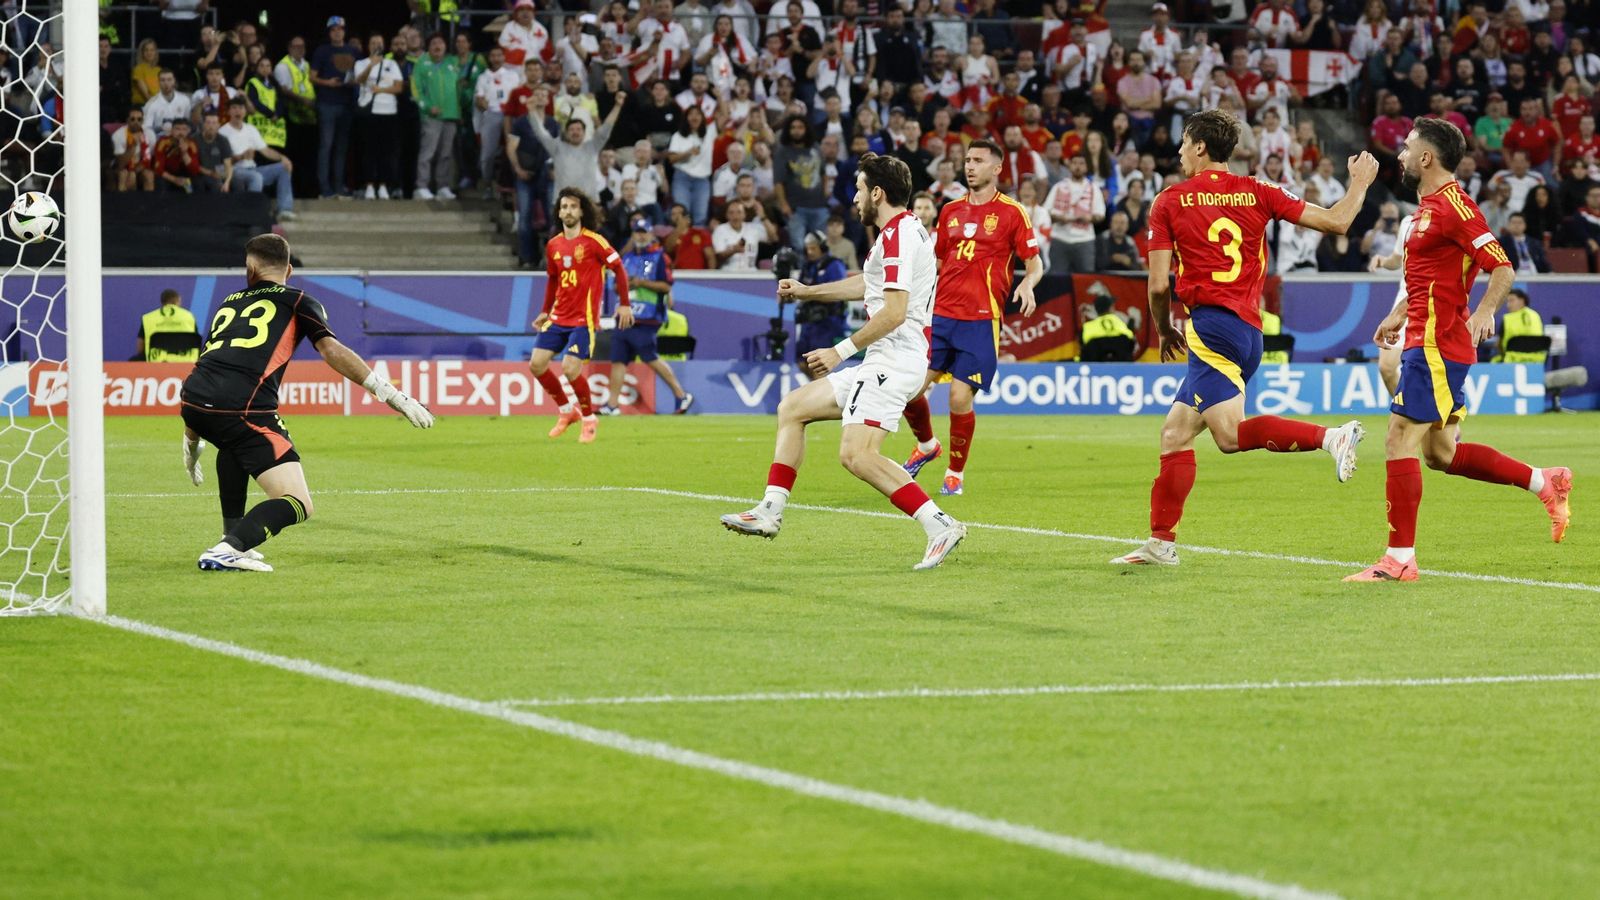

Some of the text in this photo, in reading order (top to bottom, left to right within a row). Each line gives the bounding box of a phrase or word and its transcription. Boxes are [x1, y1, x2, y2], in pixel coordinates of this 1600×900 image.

[1180, 192, 1257, 207] LE NORMAND
[956, 240, 976, 261] 14
[1207, 216, 1243, 283] 3
[561, 269, 577, 288] 24
[200, 299, 276, 357] 23
[1000, 312, 1062, 346] Nord
[852, 380, 865, 404] 7
[974, 365, 1184, 415] Booking.c
